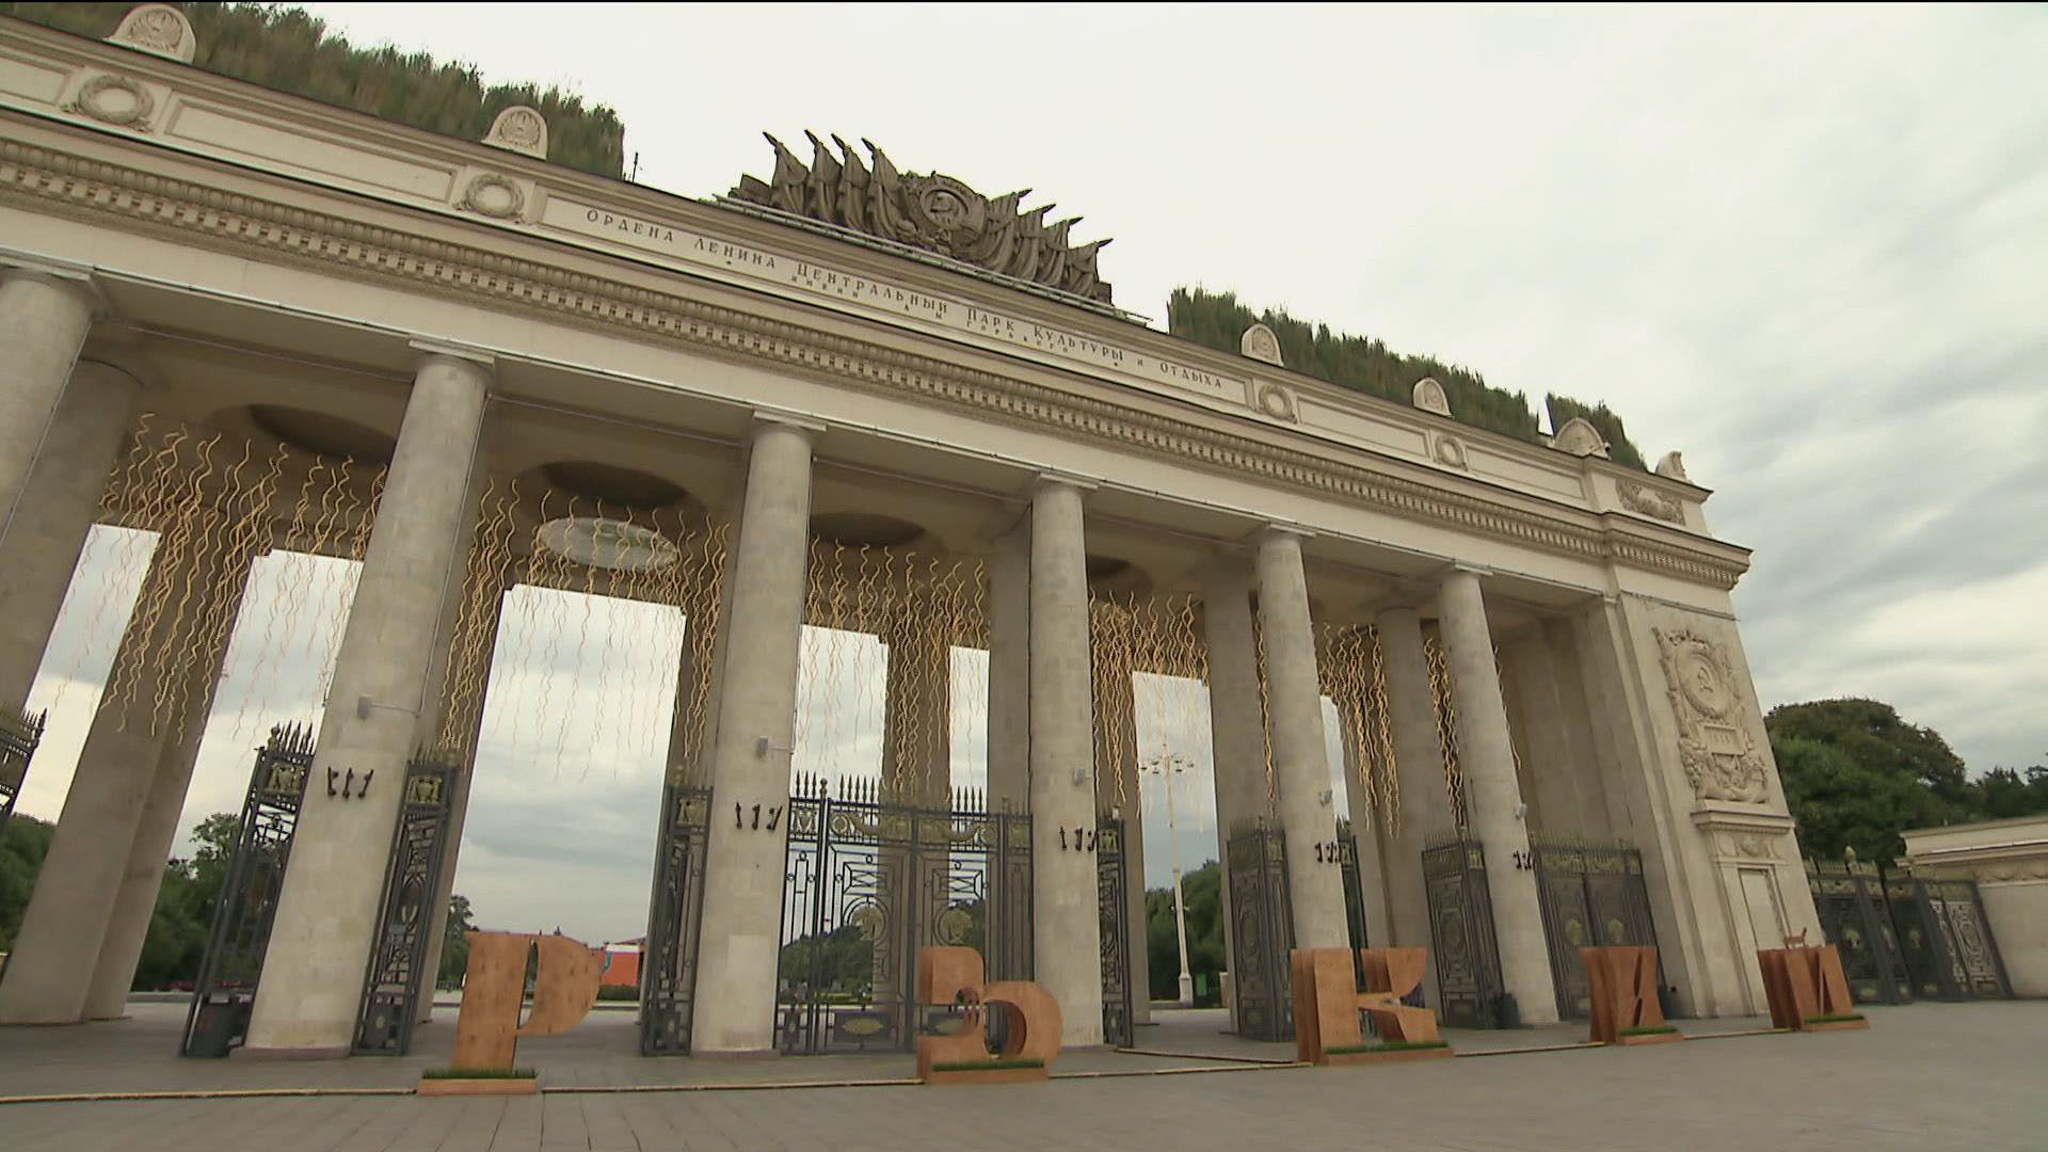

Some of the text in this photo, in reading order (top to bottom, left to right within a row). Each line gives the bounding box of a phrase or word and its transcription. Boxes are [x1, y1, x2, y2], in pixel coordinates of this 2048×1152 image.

[586, 208, 673, 242] ОРДЕНА
[693, 238, 775, 269] ЛЕНИНА
[796, 263, 948, 314] ЦЕНТРАЛЬНЫЙ
[967, 308, 1015, 332] ПАРК
[1034, 325, 1124, 361] КУЛЬТУРЫ
[1160, 361, 1221, 389] ОТДЫХА
